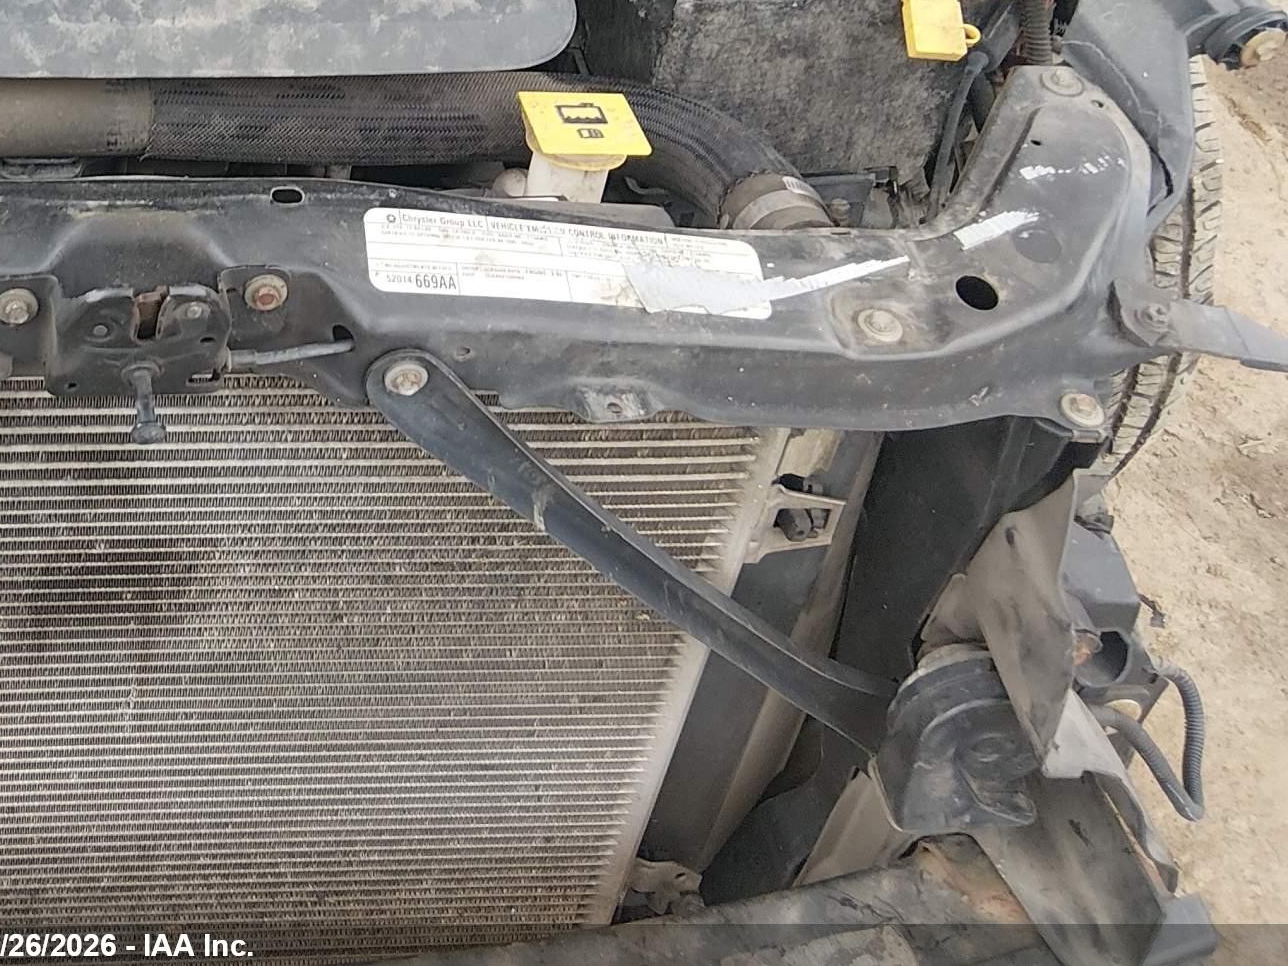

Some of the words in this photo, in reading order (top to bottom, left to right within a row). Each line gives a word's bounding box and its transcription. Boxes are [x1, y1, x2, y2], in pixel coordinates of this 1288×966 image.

[402, 214, 437, 226] Chrysler
[439, 217, 465, 228] Group
[467, 219, 484, 229] LLC
[490, 221, 523, 233] VEHICLE
[415, 274, 457, 290] 669AA
